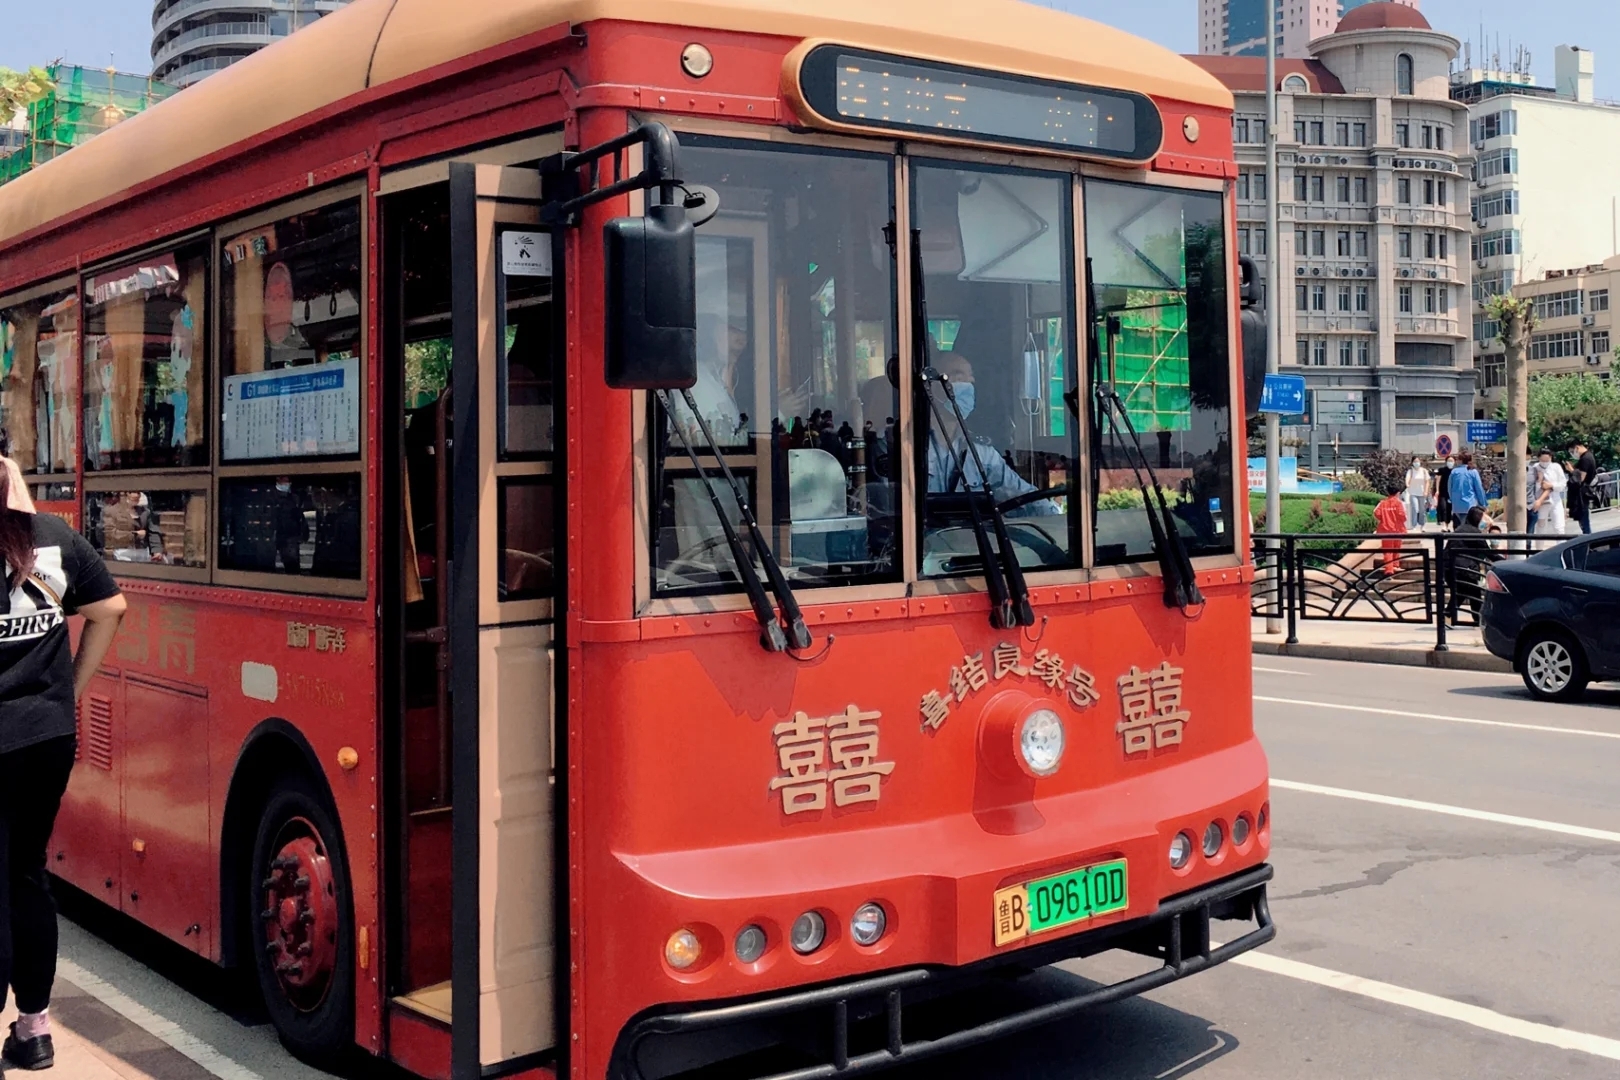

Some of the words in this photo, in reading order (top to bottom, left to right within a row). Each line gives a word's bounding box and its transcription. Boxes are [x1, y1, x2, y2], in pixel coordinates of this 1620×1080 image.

[919, 642, 1101, 731] 喜结良缘号
